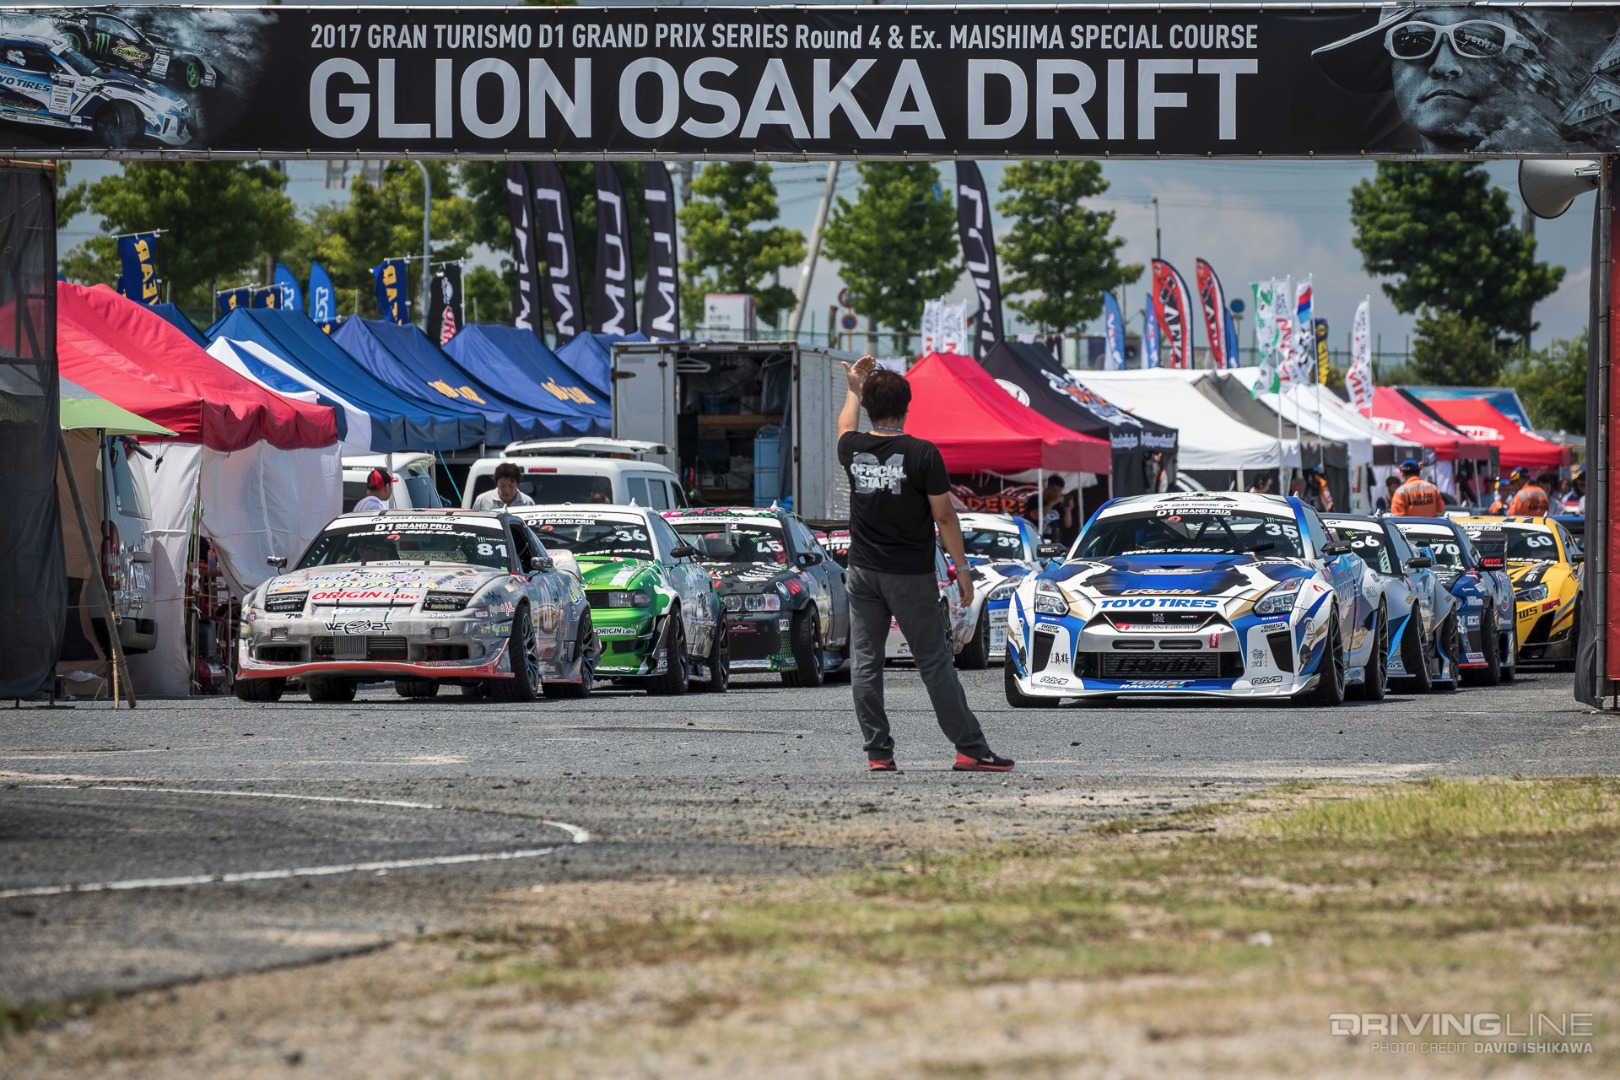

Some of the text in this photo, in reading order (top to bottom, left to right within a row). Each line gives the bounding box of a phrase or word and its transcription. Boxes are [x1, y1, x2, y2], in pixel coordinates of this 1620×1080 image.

[311, 24, 1258, 50] 2017 GRAN TURISMO D1 GRAND PRIX SERIES Round 4 & Ex. MAISHIMA SPECIAL COURSE
[115, 46, 147, 61] SUNOCO
[17, 79, 51, 92] TIRES
[310, 57, 1259, 140] GLION OSAKA DRIFT
[850, 463, 907, 479] OFFICIAL
[860, 476, 898, 490] STAFF
[374, 523, 395, 531] D1
[1264, 523, 1299, 538] 35
[615, 529, 648, 542] 36
[1526, 535, 1553, 548] 60
[757, 540, 784, 553] 45
[997, 537, 1021, 548] 39
[1429, 543, 1460, 555] 70
[476, 543, 508, 558] 81
[311, 590, 382, 600] ORIGIN
[1101, 598, 1220, 609] TOYO TIRES
[595, 627, 622, 635] ORIGIN
[1040, 675, 1069, 686] RAYS
[1251, 675, 1284, 687] RAYS
